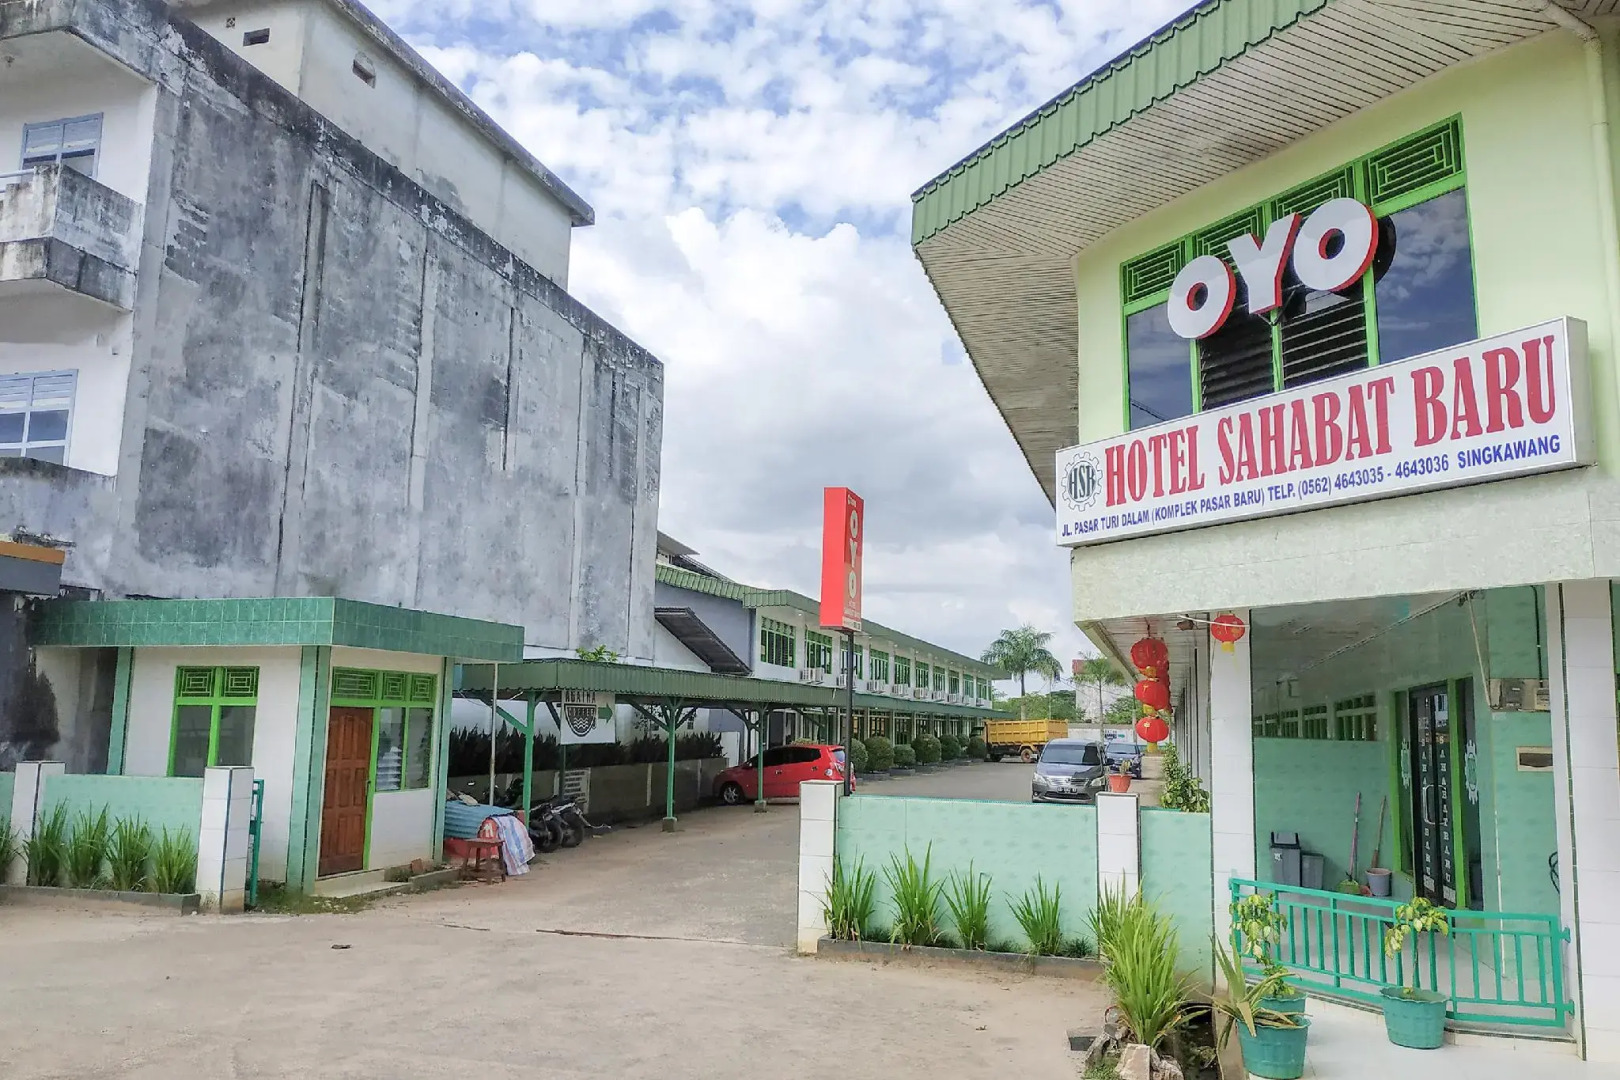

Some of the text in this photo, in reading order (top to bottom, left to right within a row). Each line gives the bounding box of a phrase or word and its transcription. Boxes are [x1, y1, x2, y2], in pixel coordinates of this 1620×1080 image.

[1167, 198, 1378, 339] OYO
[1105, 335, 1556, 507] HOTEL SAHABAT BARU
[1062, 524, 1073, 537] JL.
[1074, 518, 1099, 534] PASAR
[1101, 514, 1119, 530] TURI
[1121, 510, 1149, 526] DALAM
[1151, 500, 1198, 525] (KOMPLEK
[1200, 495, 1231, 514] PASAR
[1234, 487, 1265, 507] BARU)
[1267, 483, 1296, 501] TELP.
[1298, 476, 1332, 501] (0562)
[1334, 466, 1384, 490] 4643035
[1395, 454, 1449, 479] 4643036
[1457, 434, 1561, 469] SINGKAWANG
[848, 509, 859, 599] OYO
